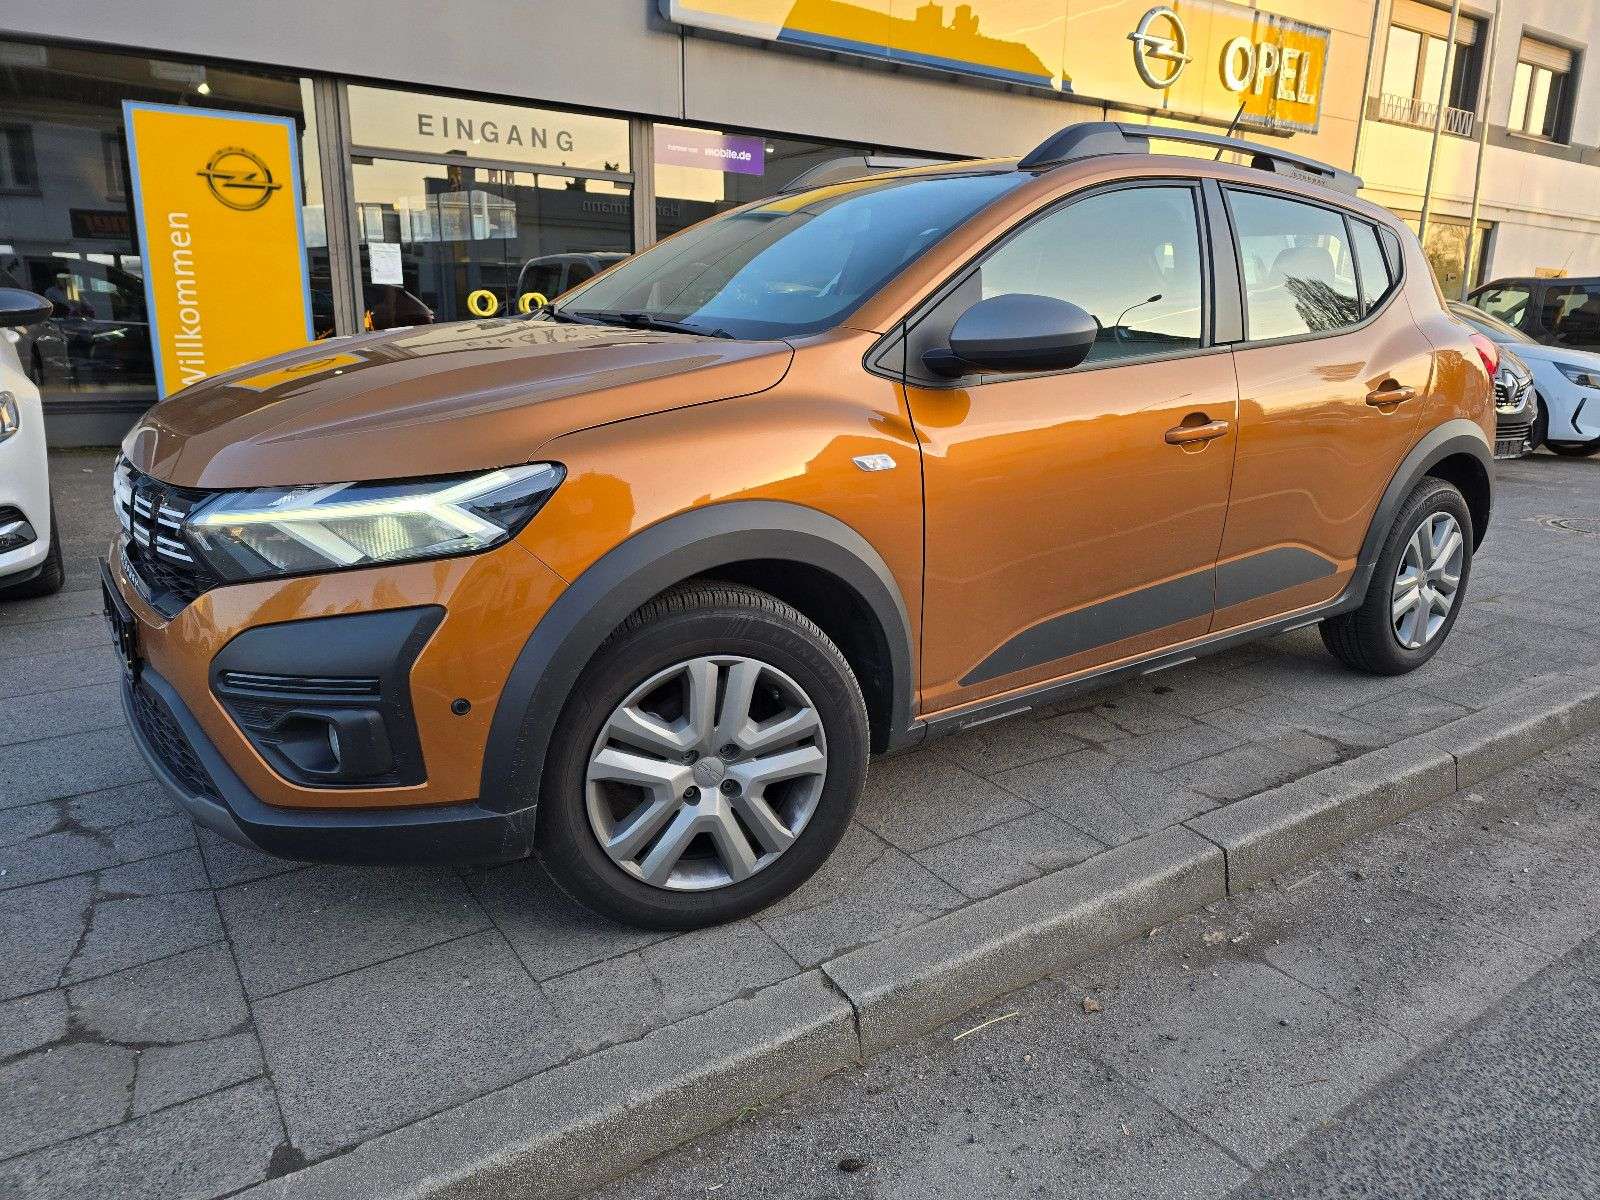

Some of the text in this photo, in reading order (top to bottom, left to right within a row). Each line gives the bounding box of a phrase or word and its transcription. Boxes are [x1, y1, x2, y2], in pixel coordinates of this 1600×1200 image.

[1219, 36, 1316, 104] OPEL
[418, 113, 574, 152] EINGANG
[704, 147, 752, 162] mobile.de
